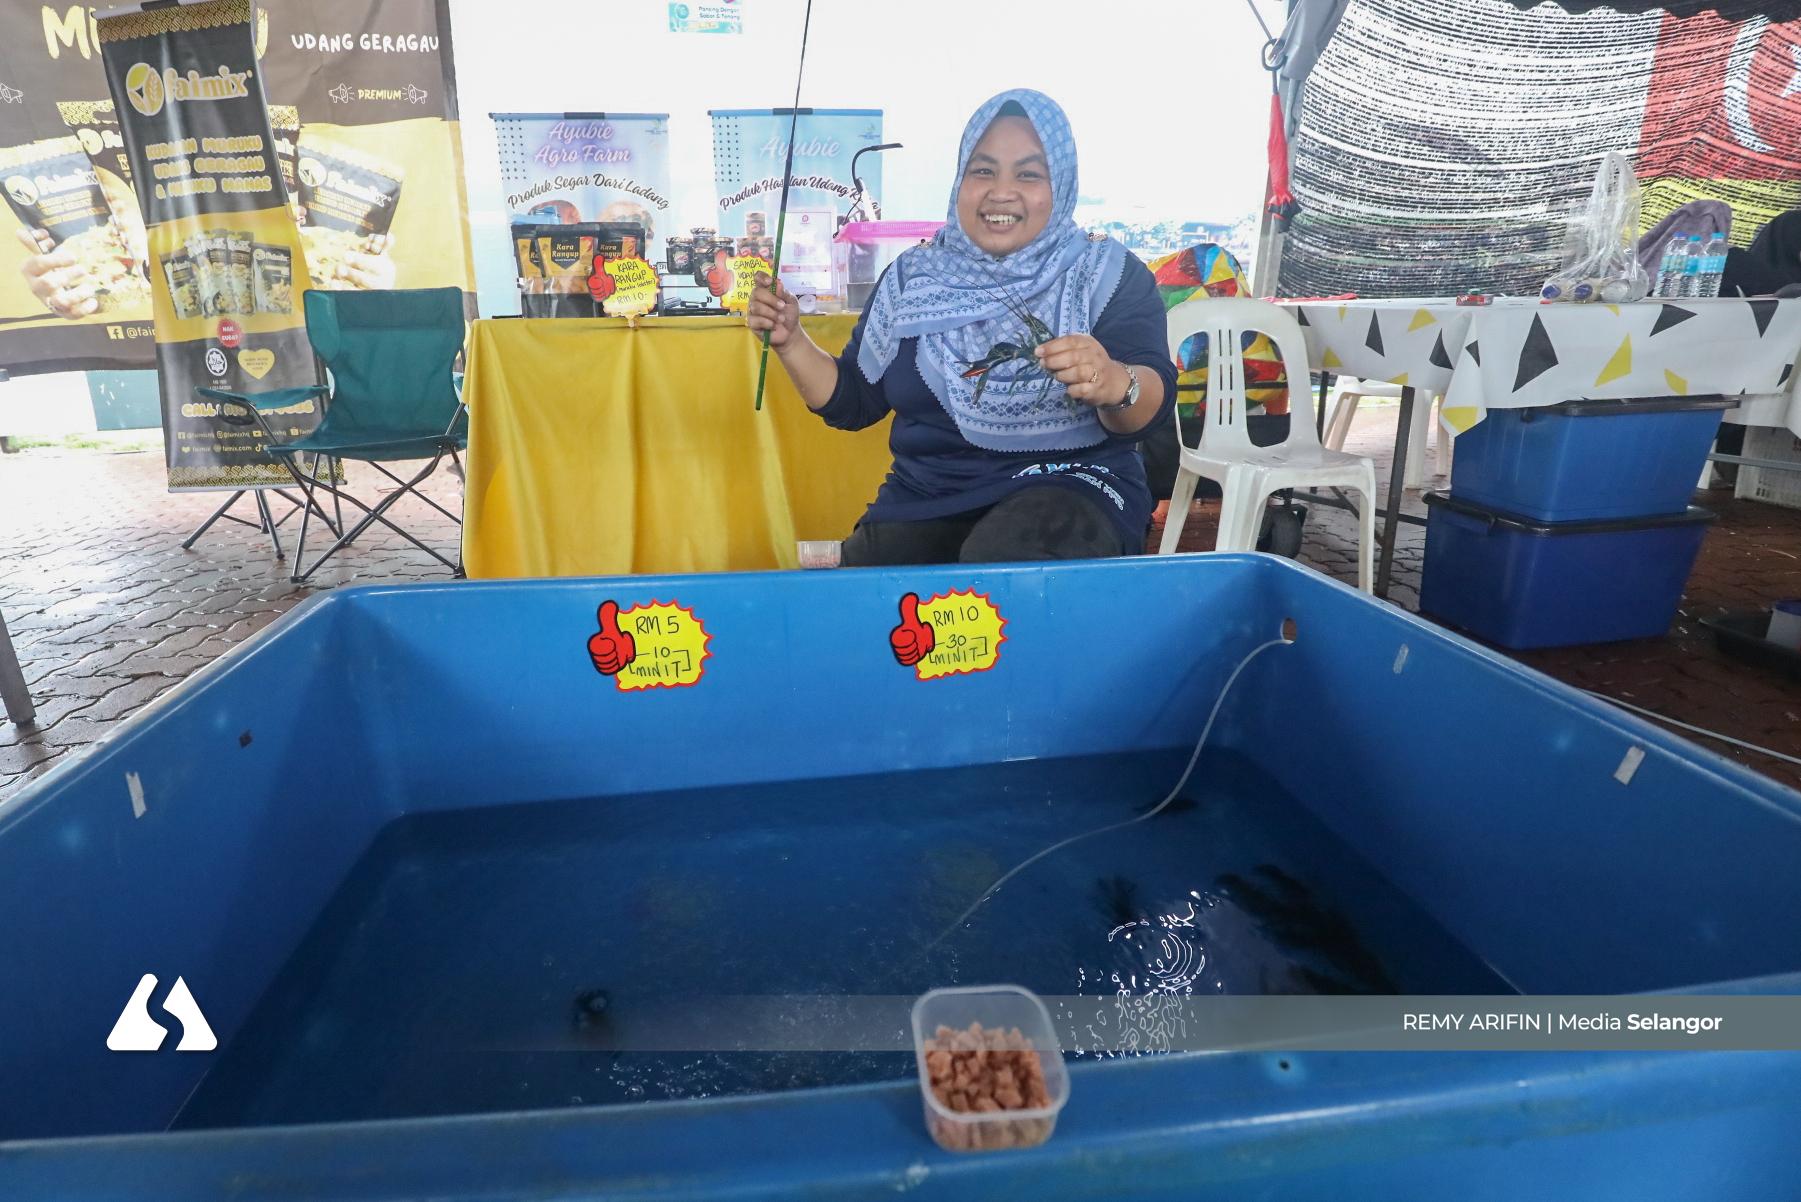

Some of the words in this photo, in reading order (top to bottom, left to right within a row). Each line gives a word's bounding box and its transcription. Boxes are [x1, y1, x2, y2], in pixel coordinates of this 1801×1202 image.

[291, 33, 354, 53] UDANG
[359, 33, 439, 53] GERAGAU
[358, 89, 402, 100] PREMIUM
[550, 121, 614, 144] Ayubie
[534, 145, 579, 168] Agro
[582, 144, 631, 162] Farm
[759, 135, 841, 164] Ayubie
[507, 180, 553, 209] Produk
[554, 175, 591, 191] Segar
[592, 173, 624, 189] Dari
[625, 180, 670, 210] Ladang
[719, 181, 762, 211] Produk
[809, 176, 849, 197] Udang
[552, 250, 579, 258] Rangup
[556, 243, 574, 251] Kara
[617, 261, 639, 272] KARA
[733, 259, 767, 270] SAMBAL
[614, 269, 647, 284] RANGUP
[636, 616, 661, 635] RM
[667, 616, 679, 634] 5
[933, 609, 955, 627] RM
[960, 605, 979, 622] 10
